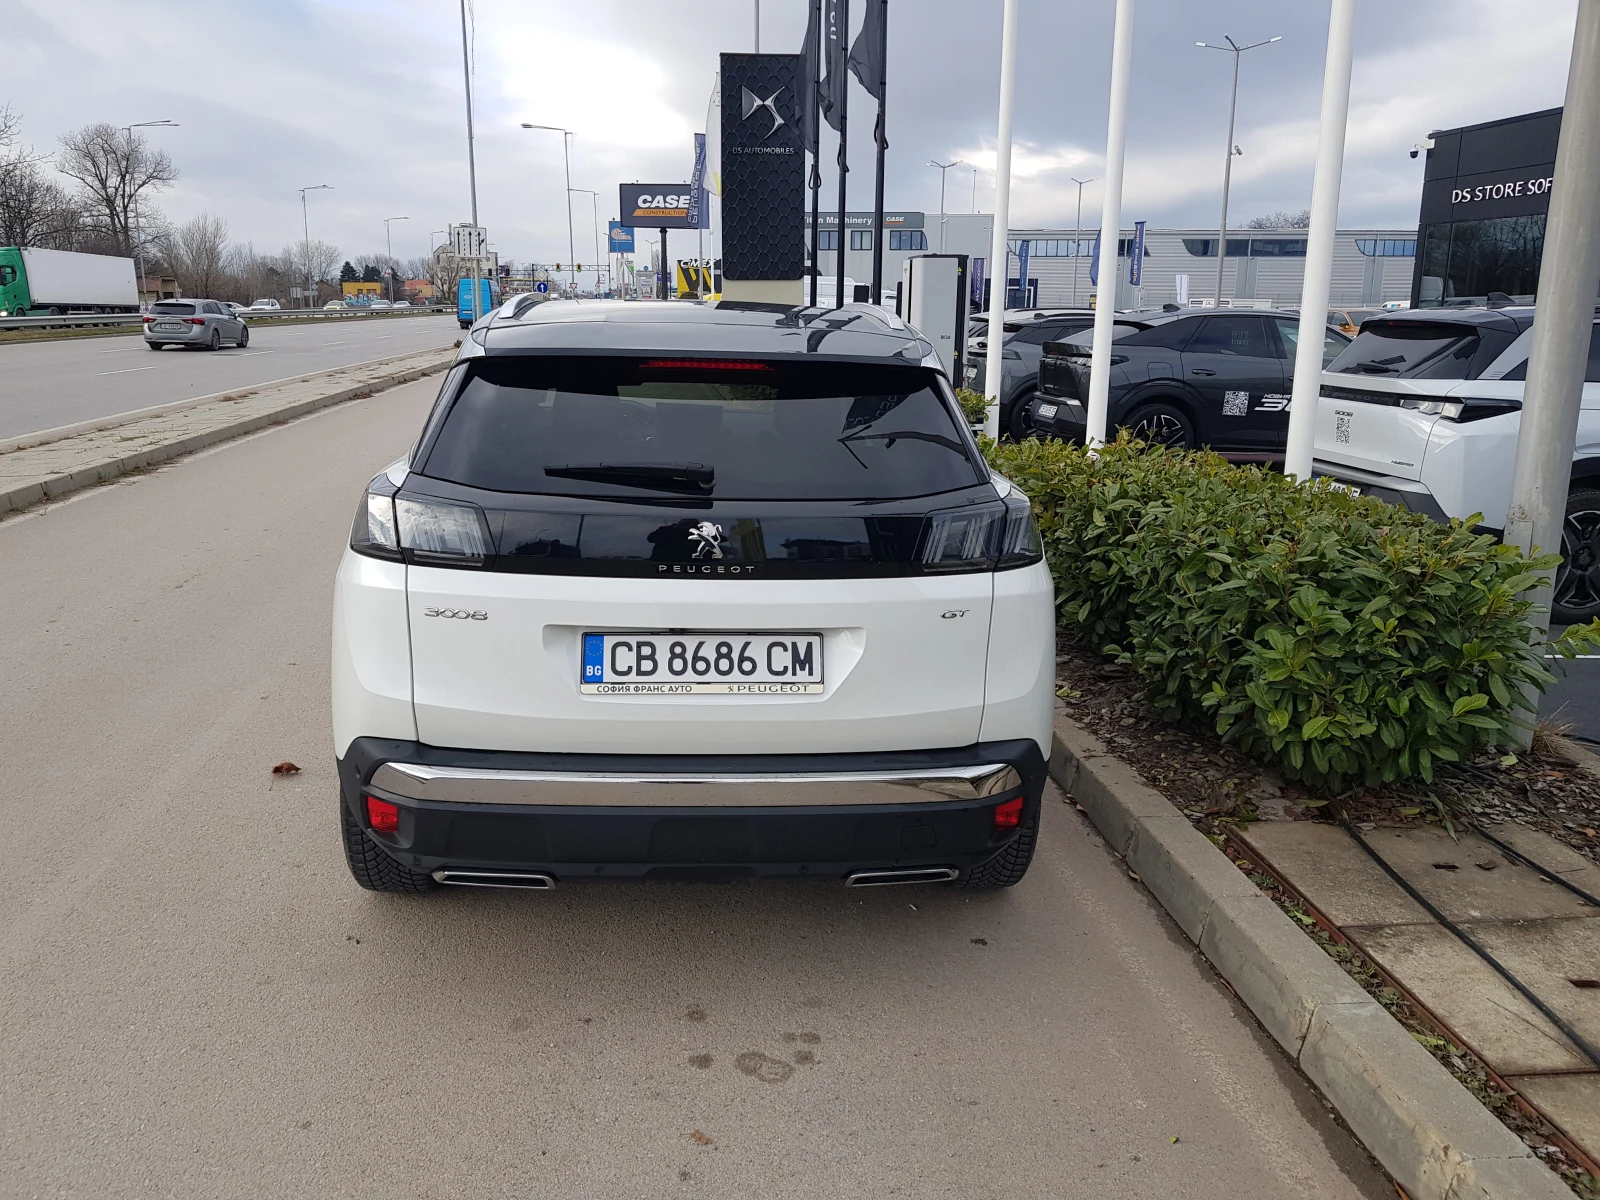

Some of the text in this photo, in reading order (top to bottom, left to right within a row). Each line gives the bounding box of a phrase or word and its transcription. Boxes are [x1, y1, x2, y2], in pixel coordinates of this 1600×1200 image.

[744, 147, 795, 155] AUTOMOBILES
[1451, 188, 1471, 204] DS
[1474, 181, 1524, 201] STORE
[637, 194, 690, 208] CASE
[826, 216, 873, 225] Mahinery
[658, 564, 755, 574] PEUGEOT
[423, 605, 489, 621] 3008
[940, 608, 971, 619] GT
[610, 641, 814, 677] CB 8686 CM
[585, 665, 602, 677] BG
[596, 685, 693, 694] СОФИЯ ФРАНС АУТО
[737, 684, 810, 693] PEUGEOT
